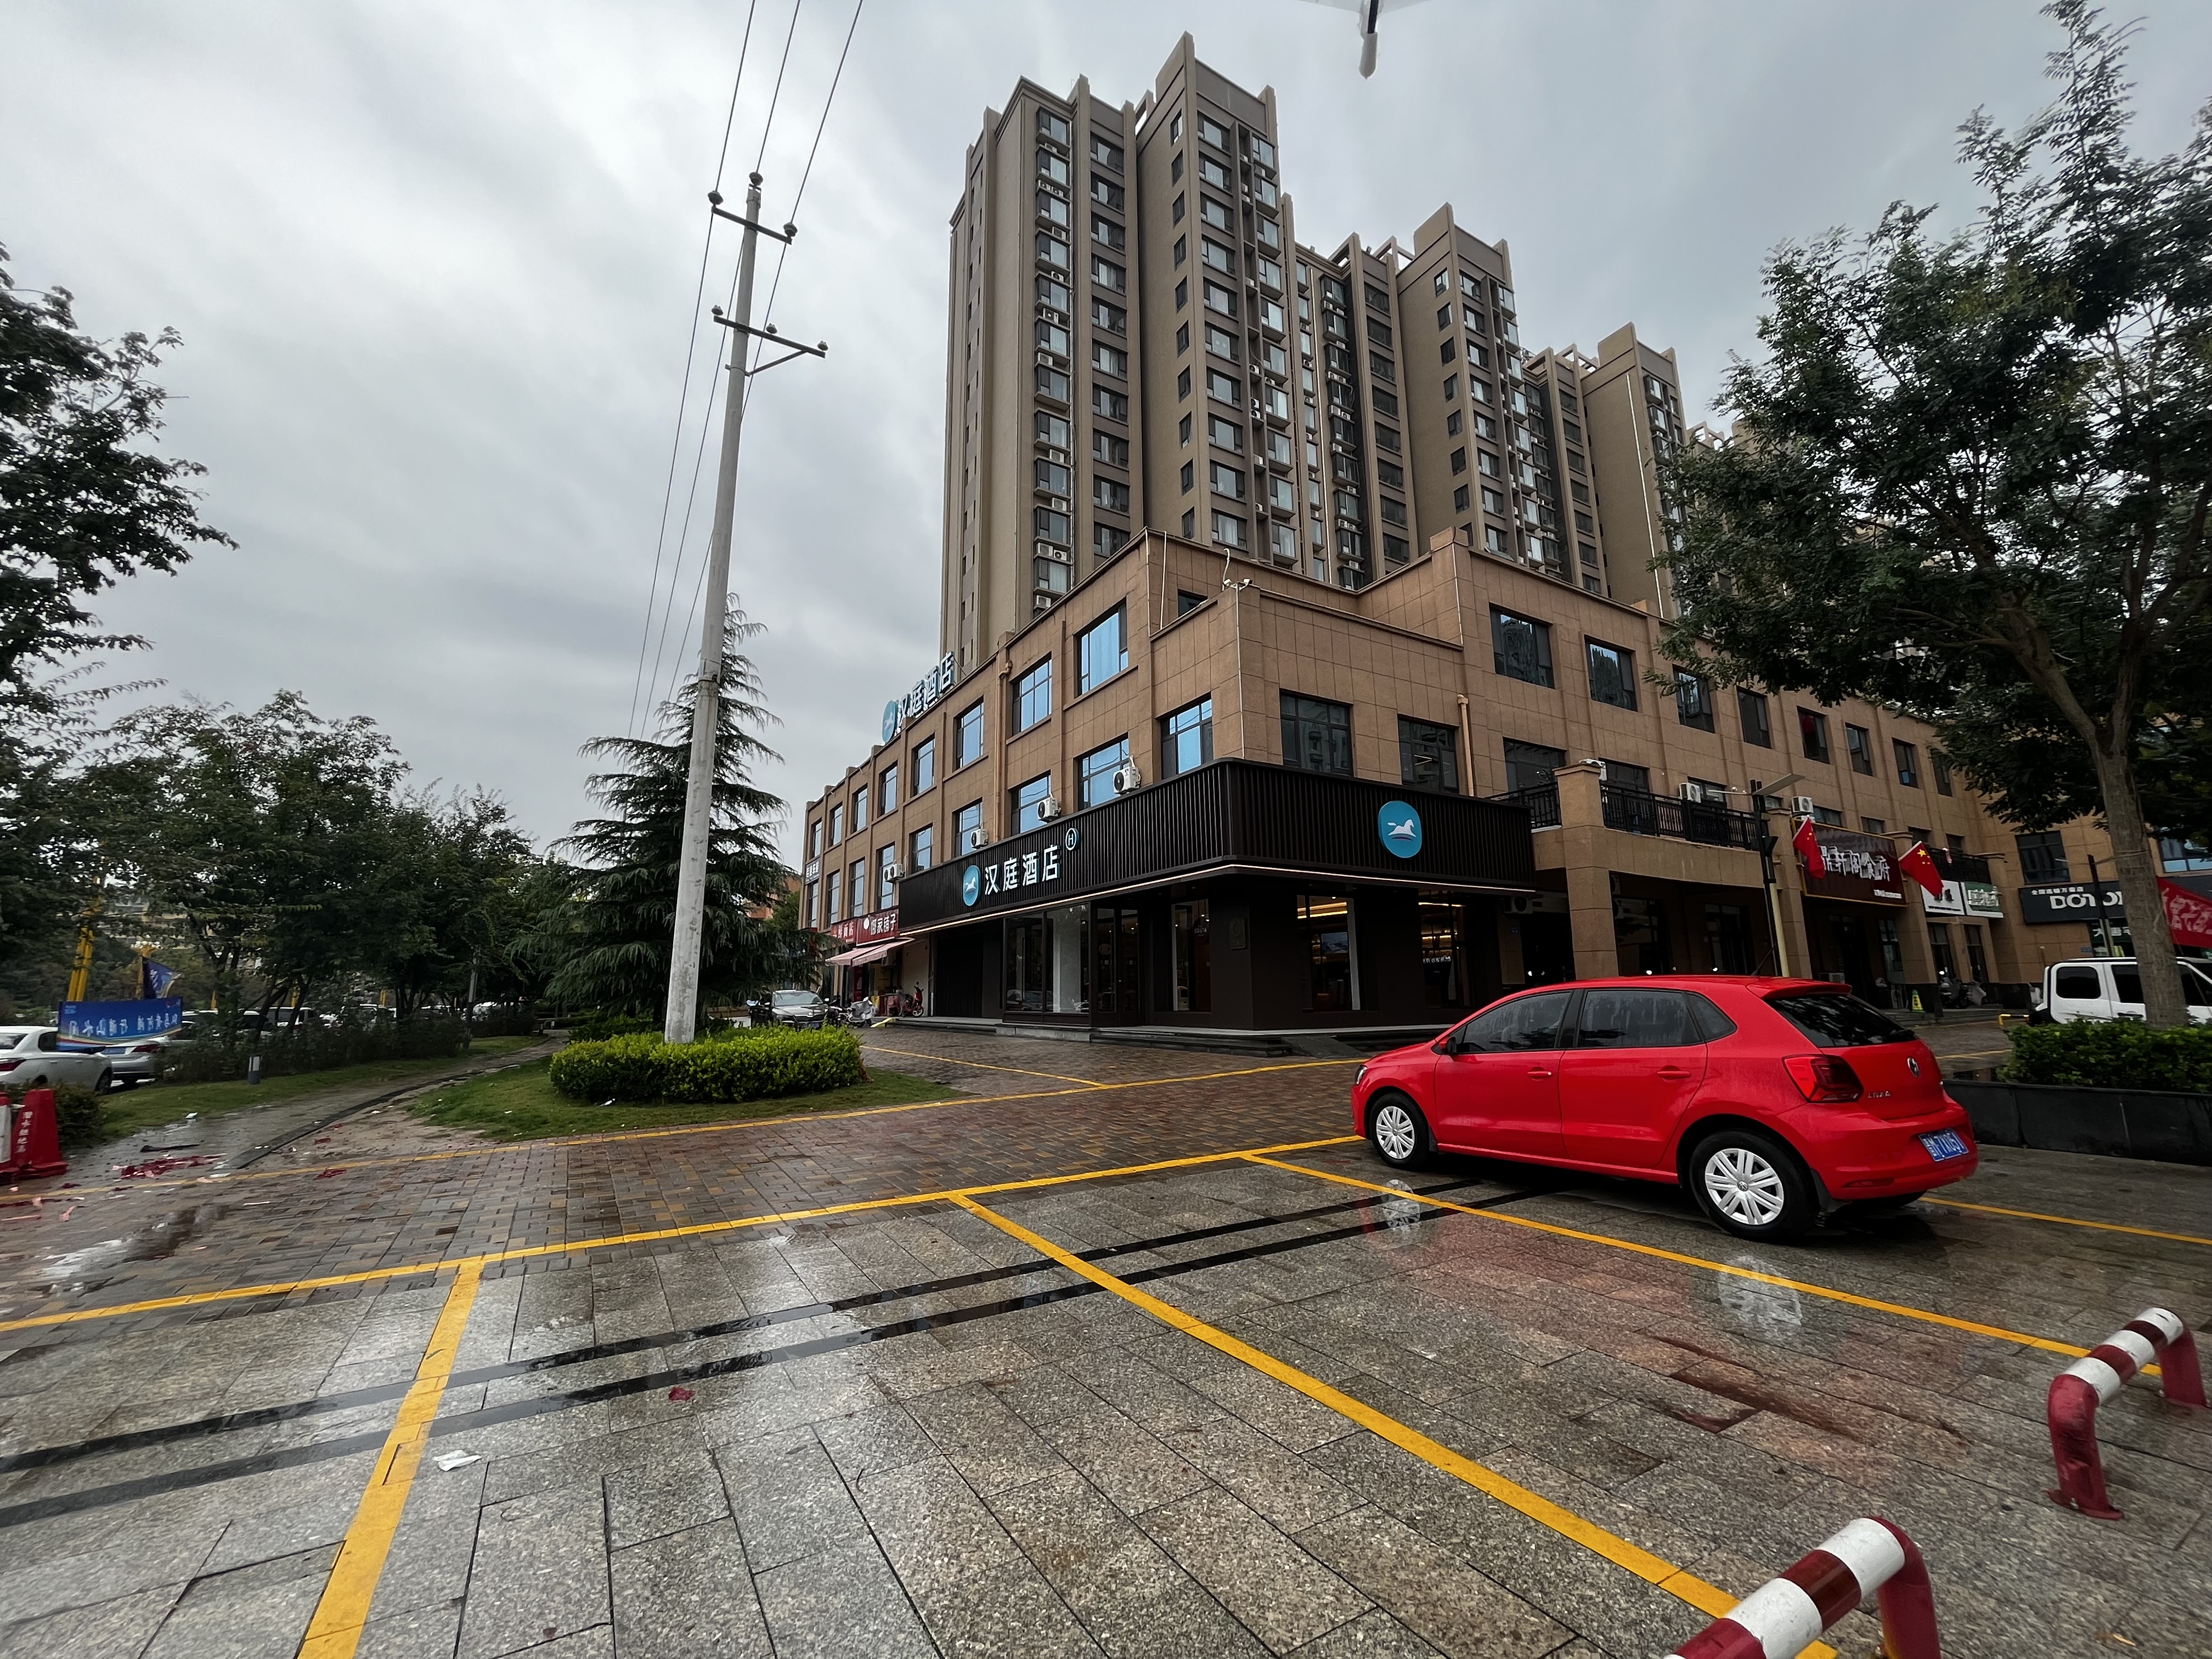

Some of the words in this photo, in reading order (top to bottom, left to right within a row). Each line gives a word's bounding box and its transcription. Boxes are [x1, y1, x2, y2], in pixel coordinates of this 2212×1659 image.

[896, 651, 955, 727] 汉庭酒店
[985, 844, 1058, 895] 汉庭酒店
